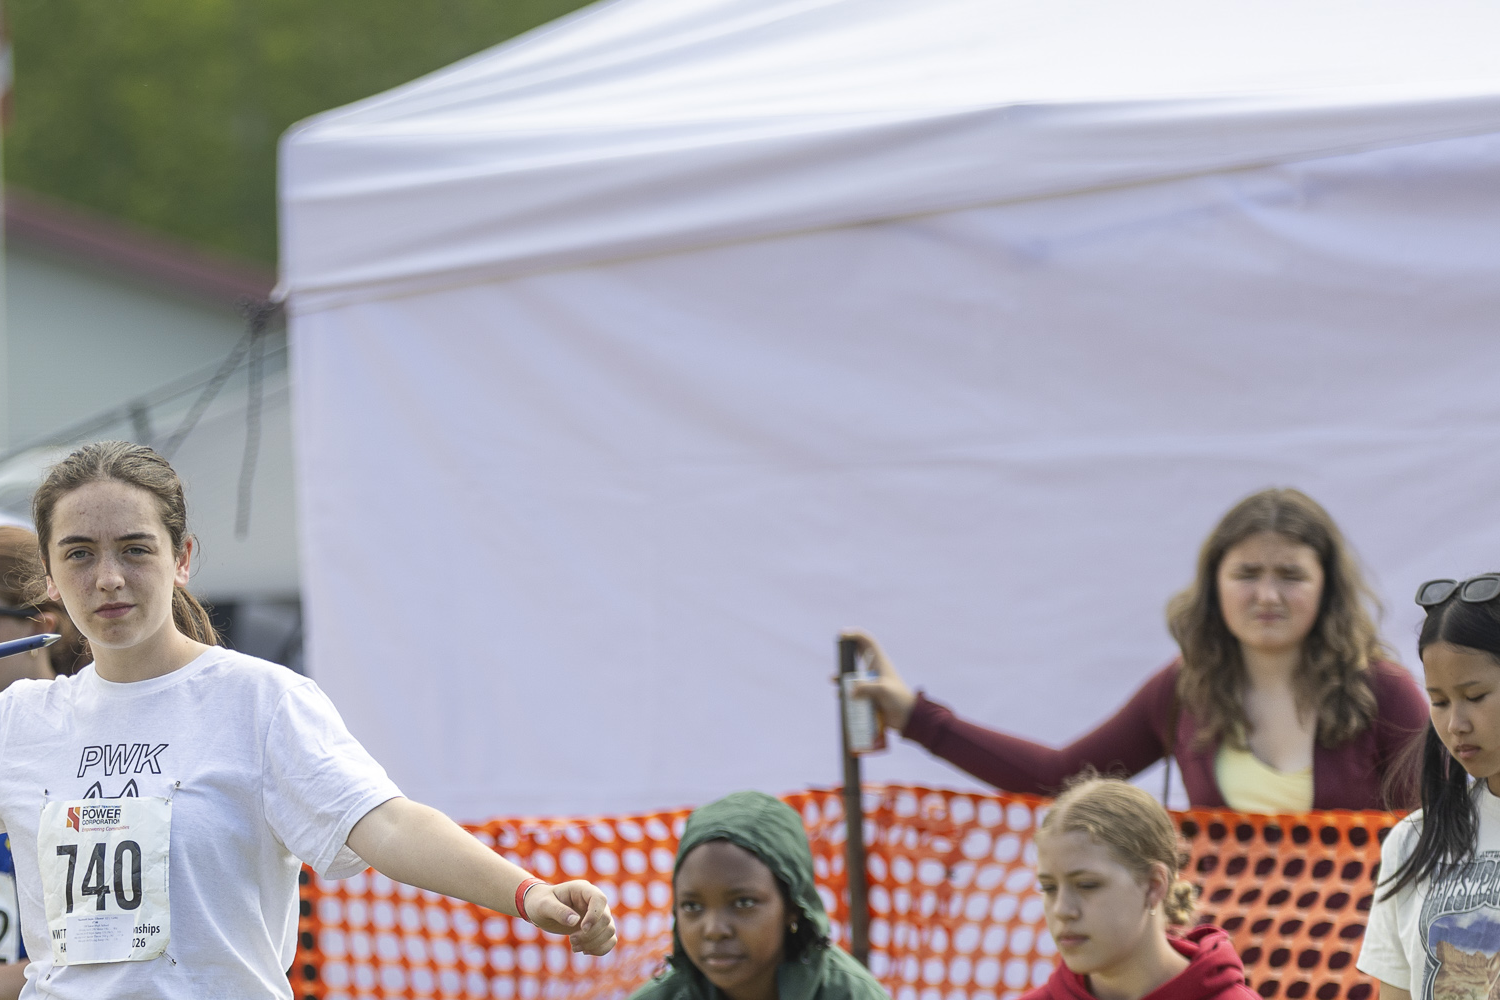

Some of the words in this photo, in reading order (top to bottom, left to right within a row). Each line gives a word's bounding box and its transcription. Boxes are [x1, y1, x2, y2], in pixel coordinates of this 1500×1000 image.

[76, 743, 169, 778] PWK
[82, 808, 121, 819] POWER
[56, 840, 142, 914] 740
